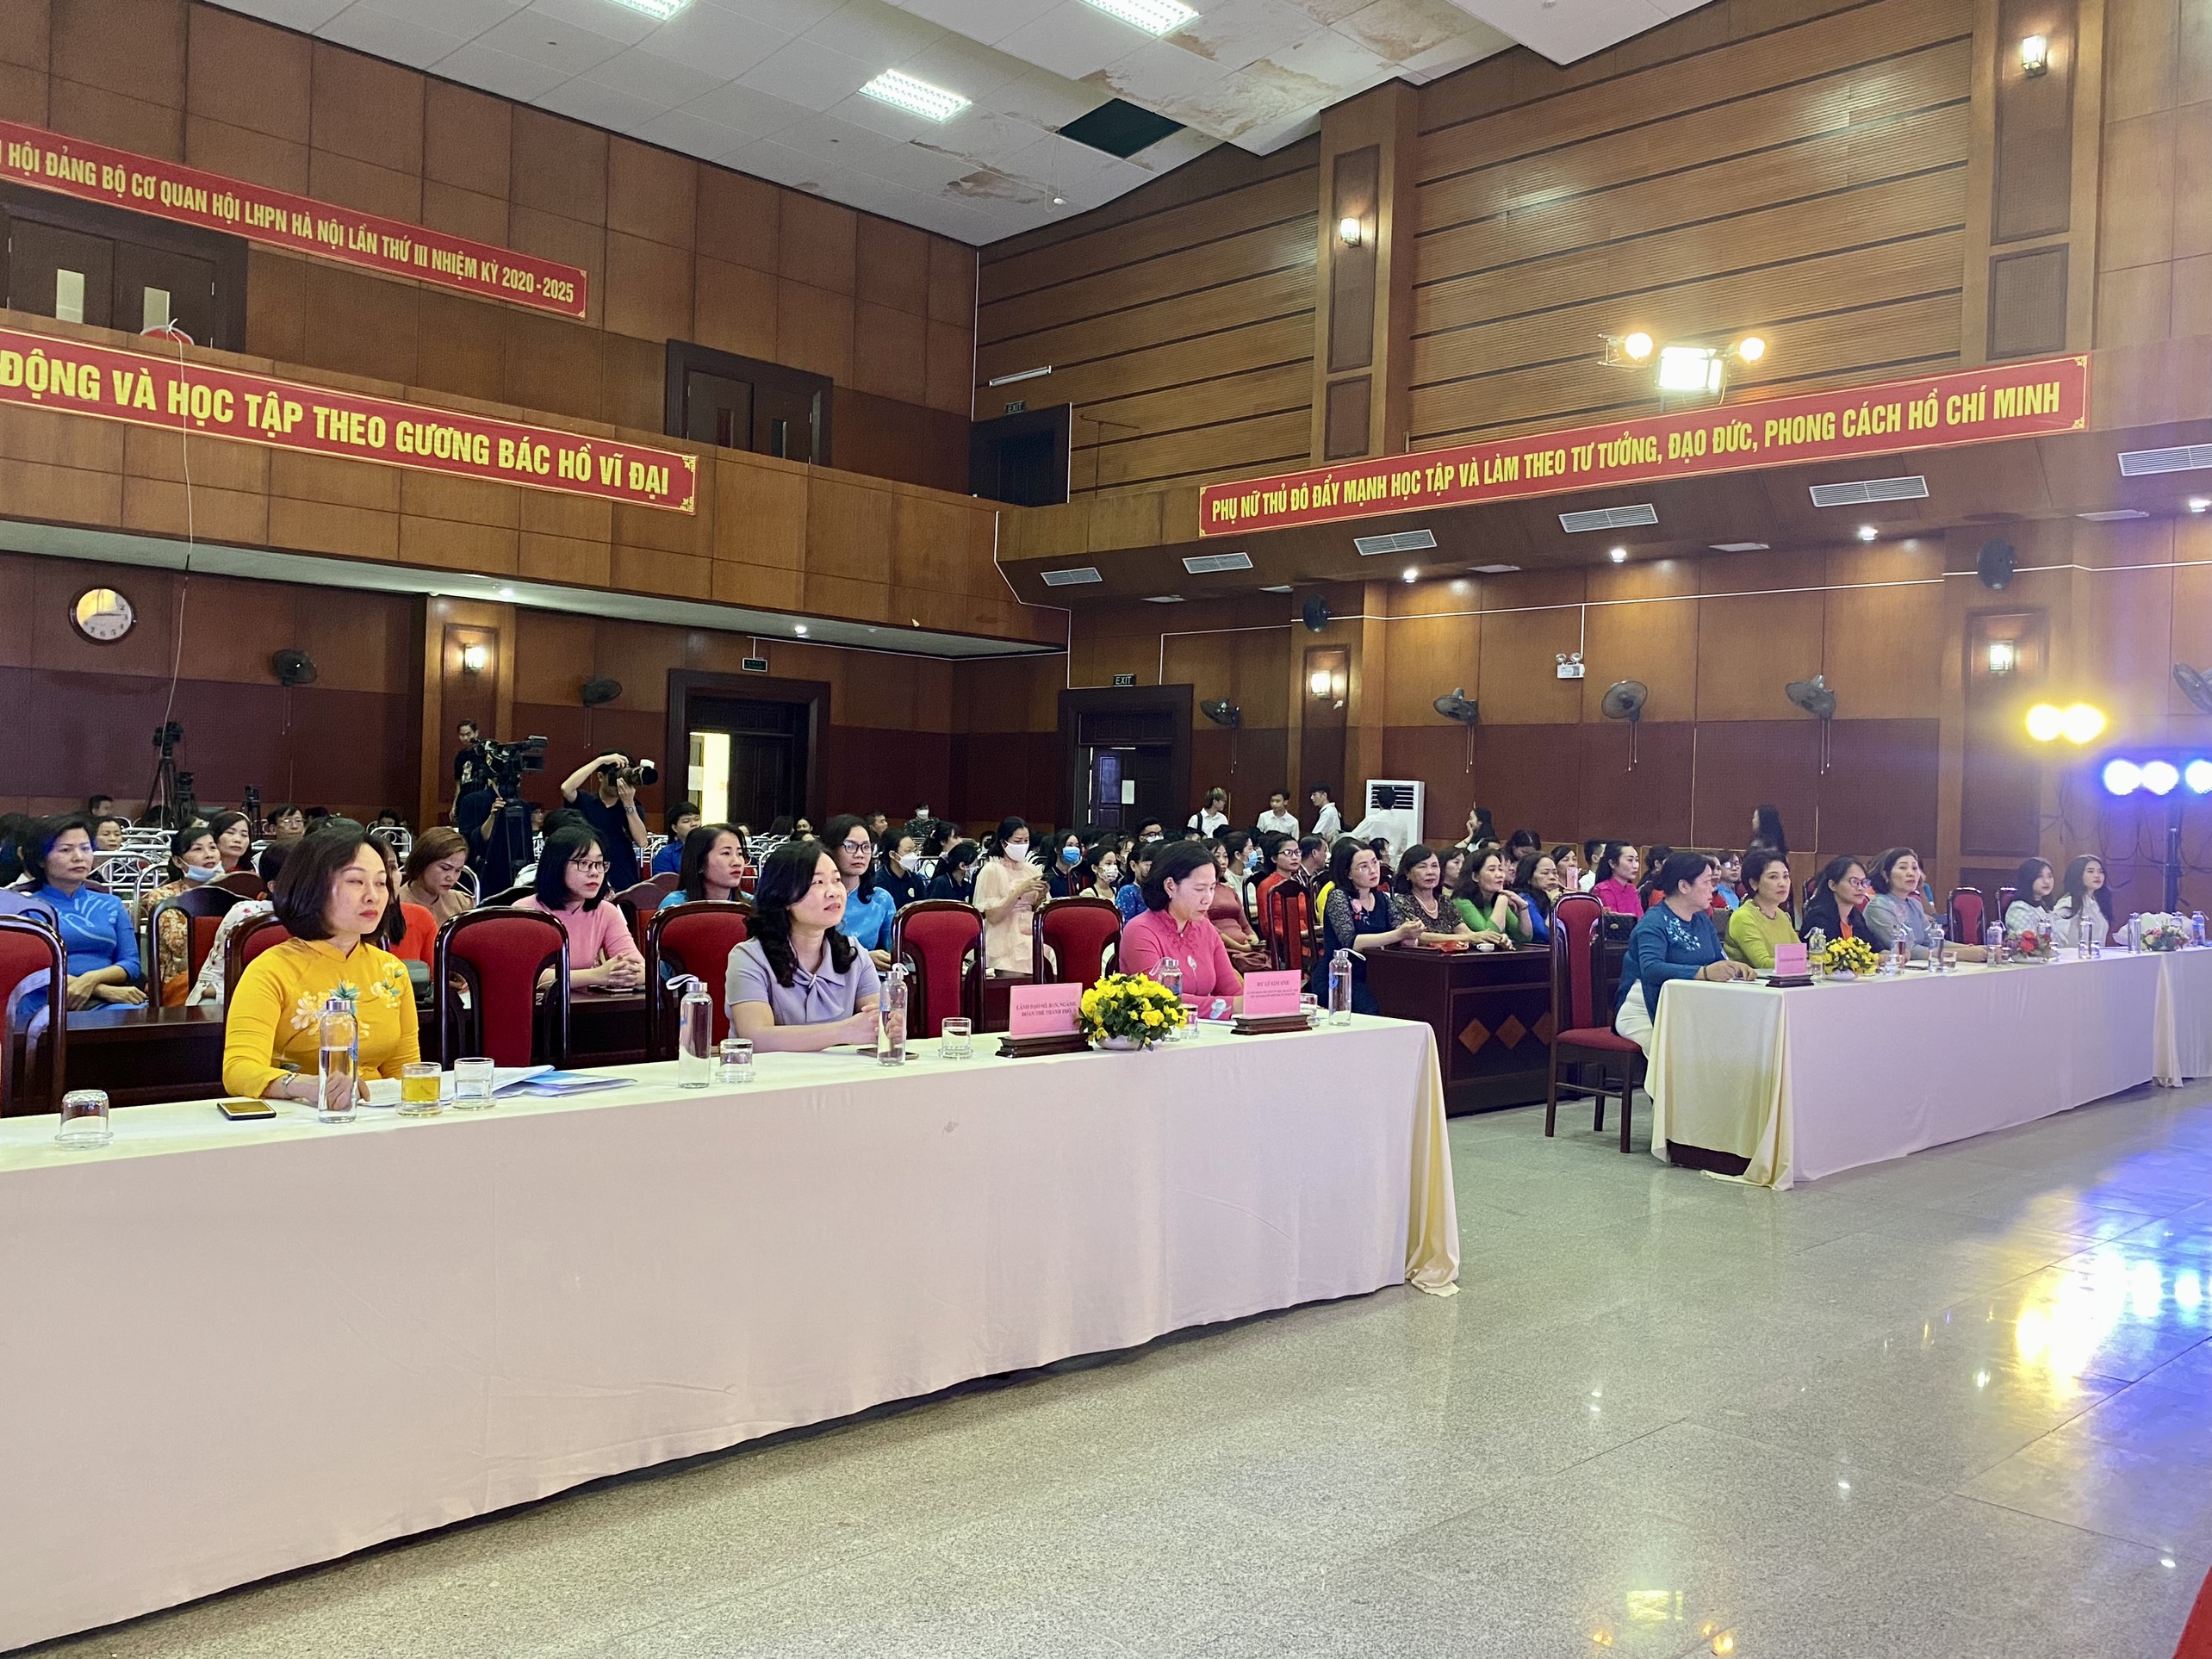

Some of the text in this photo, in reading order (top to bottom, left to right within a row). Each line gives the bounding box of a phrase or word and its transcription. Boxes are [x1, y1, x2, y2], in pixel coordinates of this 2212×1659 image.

[8, 141, 40, 179] HỘI
[46, 146, 96, 186] ĐẢNG
[103, 165, 126, 197] BỘ
[132, 173, 156, 199] CƠ
[161, 181, 207, 213] QUAN
[213, 192, 239, 224] HỘI
[245, 202, 287, 232] LHPN
[292, 212, 313, 239] HÀ
[318, 219, 344, 249] NỘI
[349, 224, 377, 254] LẦN
[382, 235, 411, 262] THỨ
[414, 244, 427, 267] III
[432, 249, 476, 280] NHIỆM
[482, 260, 498, 283] KỲ
[502, 267, 534, 293] 2020
[543, 277, 573, 302] 2025
[1, 348, 668, 500] ĐỘNG VÀ HỌC TẬP THEO GƯƠNG BÁC HỒ VĨ ĐẠI
[1008, 402, 1022, 413] EXIT
[1213, 382, 2060, 524] PHỤ NỮ THỦ ĐÔ ĐẨY MẠNH HỌC TẬP VÀ LÀM THEO TƯ TƯỞNG, ĐẠO ĐỨC, PHONG CÁCH HỒ CHÍ MINH
[1115, 676, 1132, 685] EXIT
